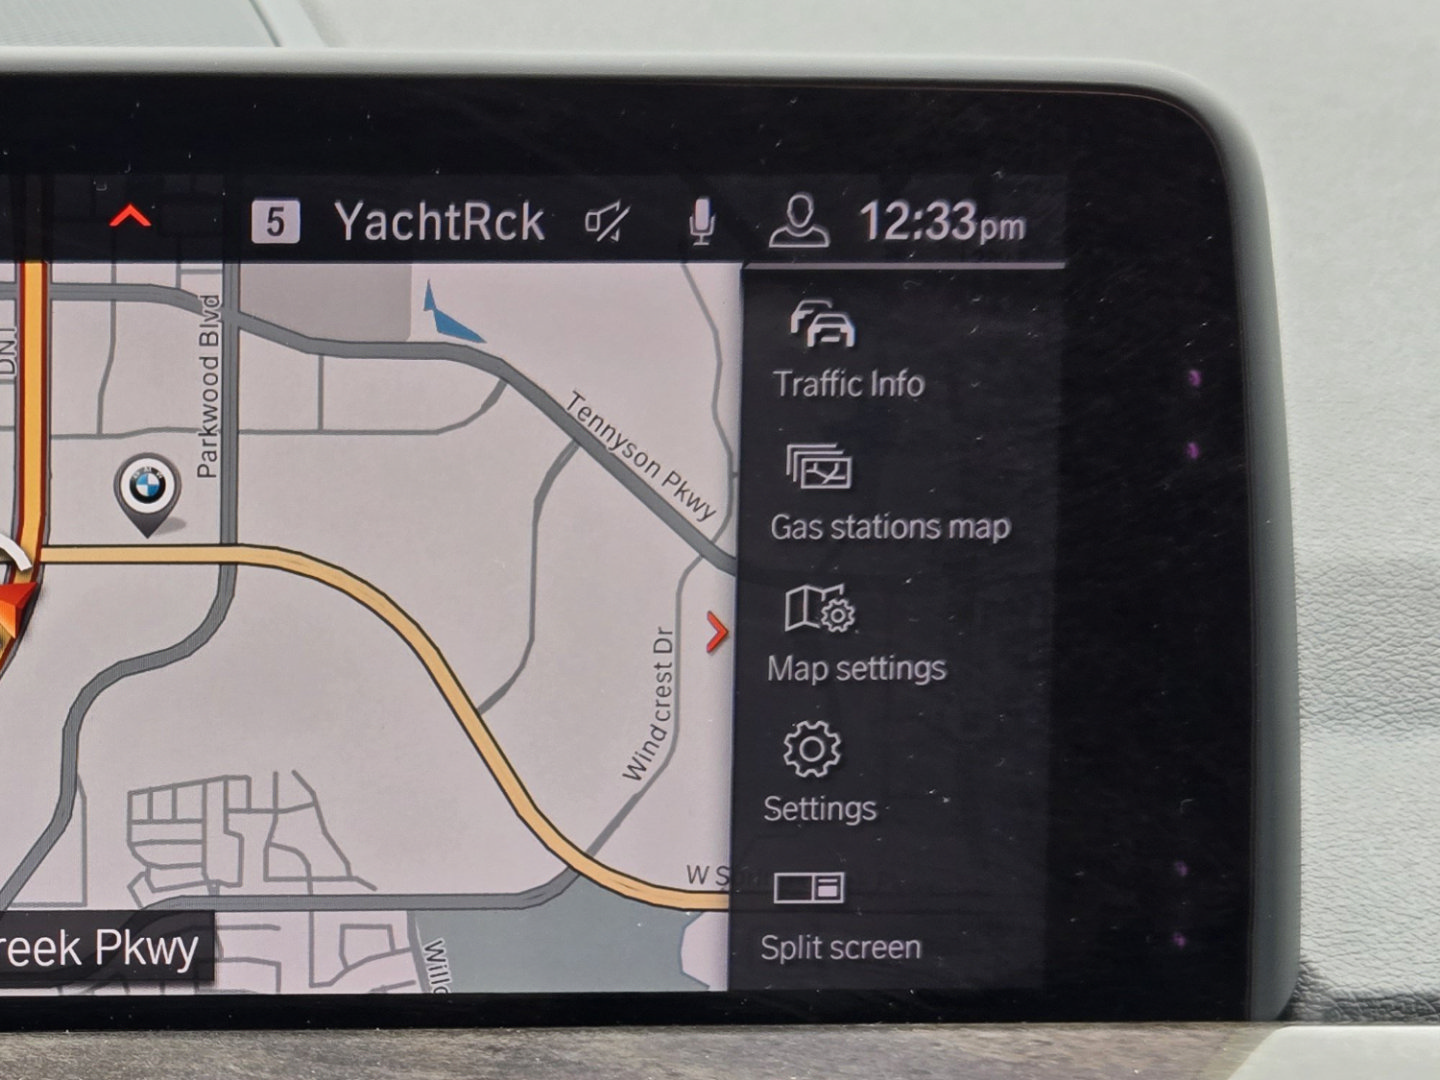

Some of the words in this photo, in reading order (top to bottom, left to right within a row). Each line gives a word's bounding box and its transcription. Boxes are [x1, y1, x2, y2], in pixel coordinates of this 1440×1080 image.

[266, 206, 285, 237] 5
[334, 200, 546, 241] YachtRck
[199, 294, 221, 347] Blvd
[773, 368, 864, 397] Traffic
[871, 368, 926, 397] Info
[197, 356, 220, 478] Parkwood
[566, 390, 661, 478] Tennyson
[661, 470, 717, 523] Pkwy
[771, 513, 823, 540] Gas
[831, 511, 942, 541] stations
[949, 516, 1012, 544] map
[767, 655, 829, 686] Map
[836, 653, 948, 685] settings
[622, 661, 673, 781] Windcrest
[653, 626, 673, 654] Dr
[764, 795, 877, 826] Settings
[687, 864, 709, 885] W
[96, 928, 199, 974] Pkwy
[761, 934, 822, 965] Split
[830, 938, 922, 960] screen
